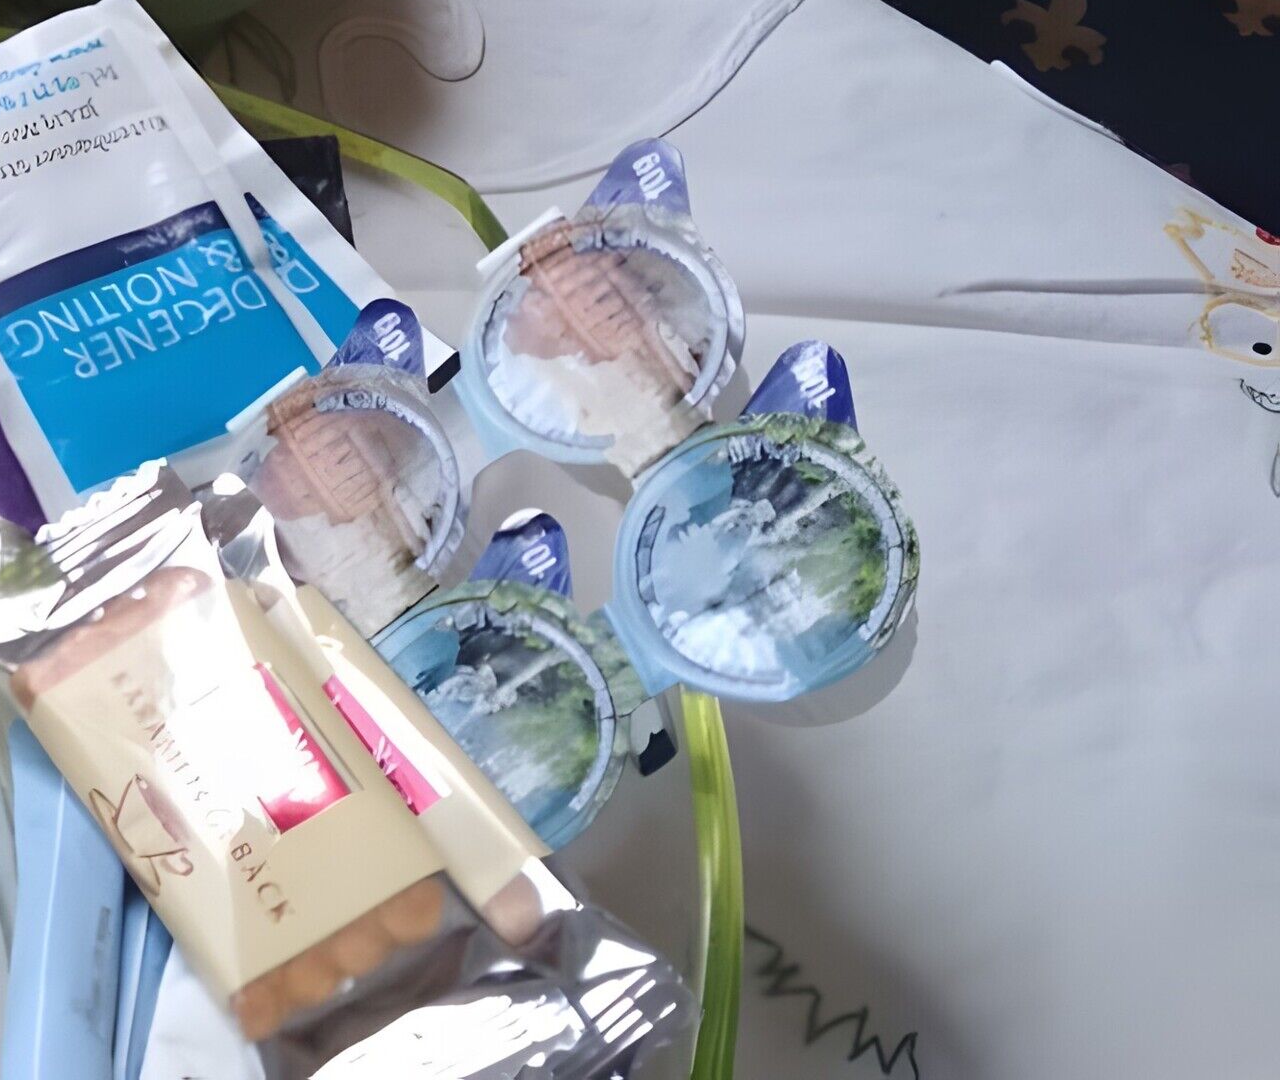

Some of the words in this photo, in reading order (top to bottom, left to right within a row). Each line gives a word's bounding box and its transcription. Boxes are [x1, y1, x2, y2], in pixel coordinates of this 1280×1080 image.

[632, 153, 672, 201] 10g
[199, 240, 245, 273] &
[5, 256, 199, 358] NOLTING
[63, 274, 268, 380] DEGENER
